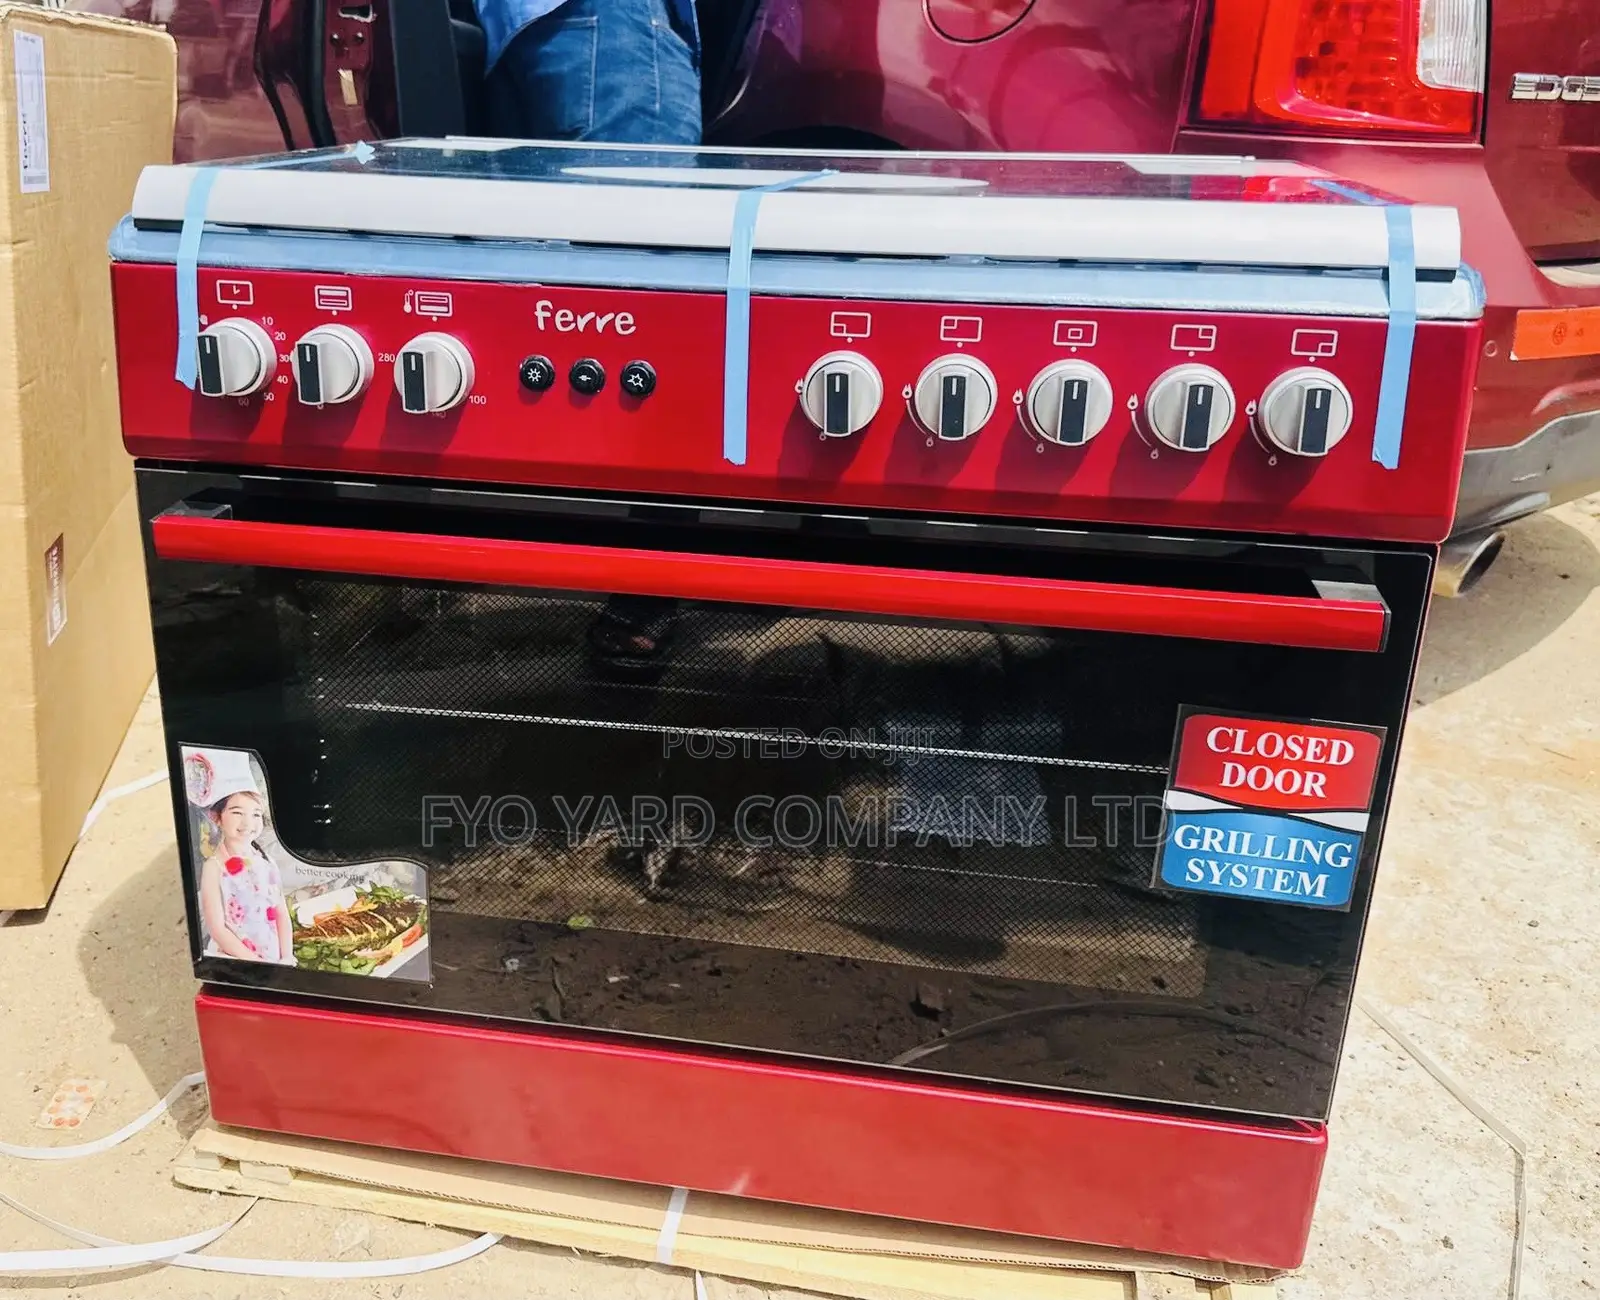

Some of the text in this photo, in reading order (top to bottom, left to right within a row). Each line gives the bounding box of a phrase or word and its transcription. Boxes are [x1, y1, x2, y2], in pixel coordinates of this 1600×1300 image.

[261, 316, 274, 325] 10
[534, 300, 637, 335] ferre
[274, 331, 286, 340] 20
[279, 354, 290, 363] 30
[377, 353, 396, 363] 280
[276, 375, 288, 384] 40
[264, 392, 275, 401] 50
[468, 395, 487, 405] 100
[1206, 726, 1355, 766] CLOSED
[1218, 761, 1327, 798] DOOR
[1173, 824, 1353, 868] GRILLING
[295, 866, 322, 877] better
[1185, 858, 1330, 898] SYSTEM
